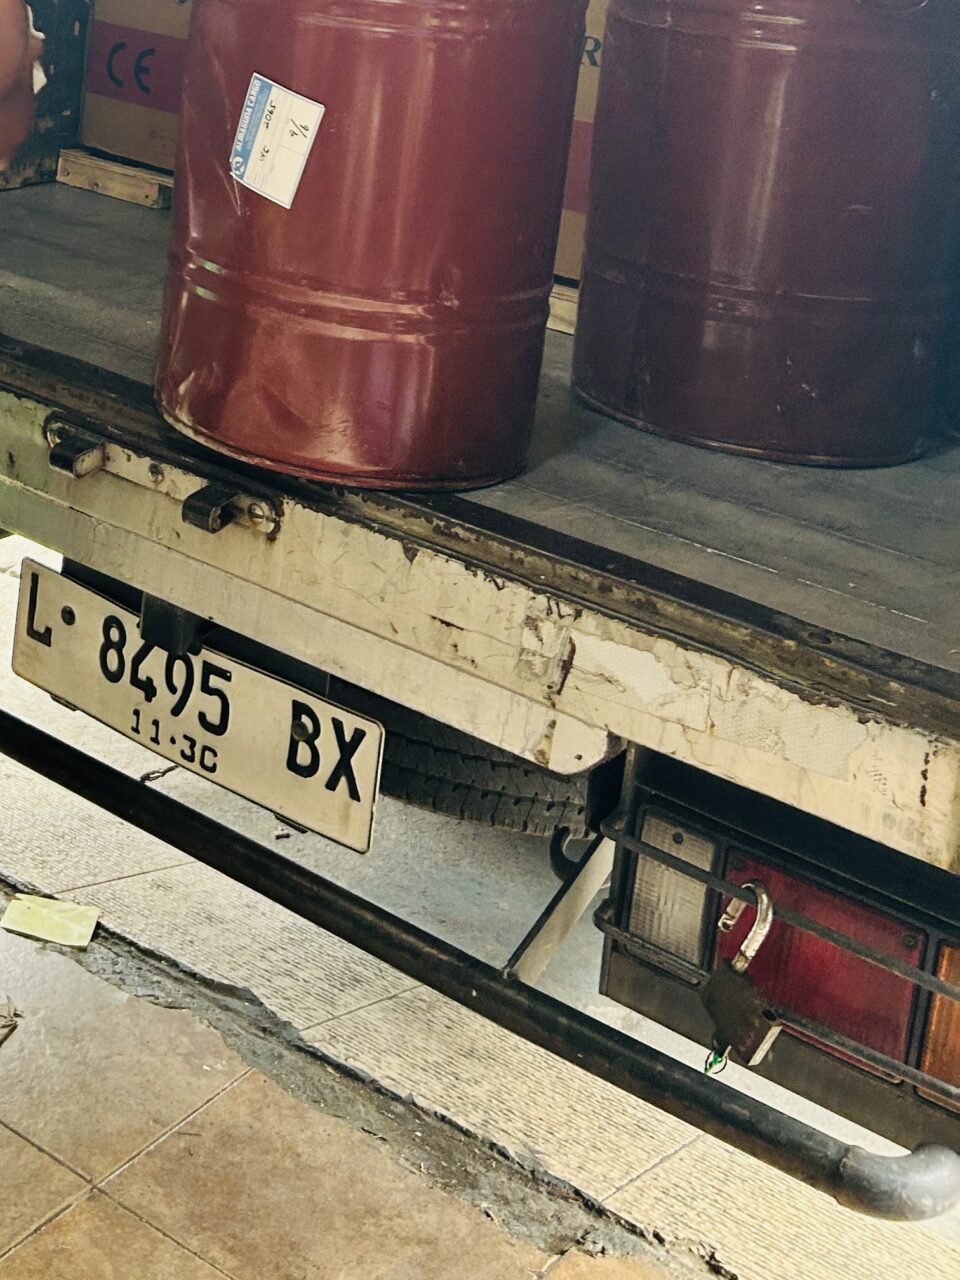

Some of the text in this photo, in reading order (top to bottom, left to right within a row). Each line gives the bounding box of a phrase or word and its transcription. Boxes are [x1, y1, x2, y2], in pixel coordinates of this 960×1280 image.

[248, 79, 262, 107] CARGO
[26, 571, 367, 803] L 8495 BX
